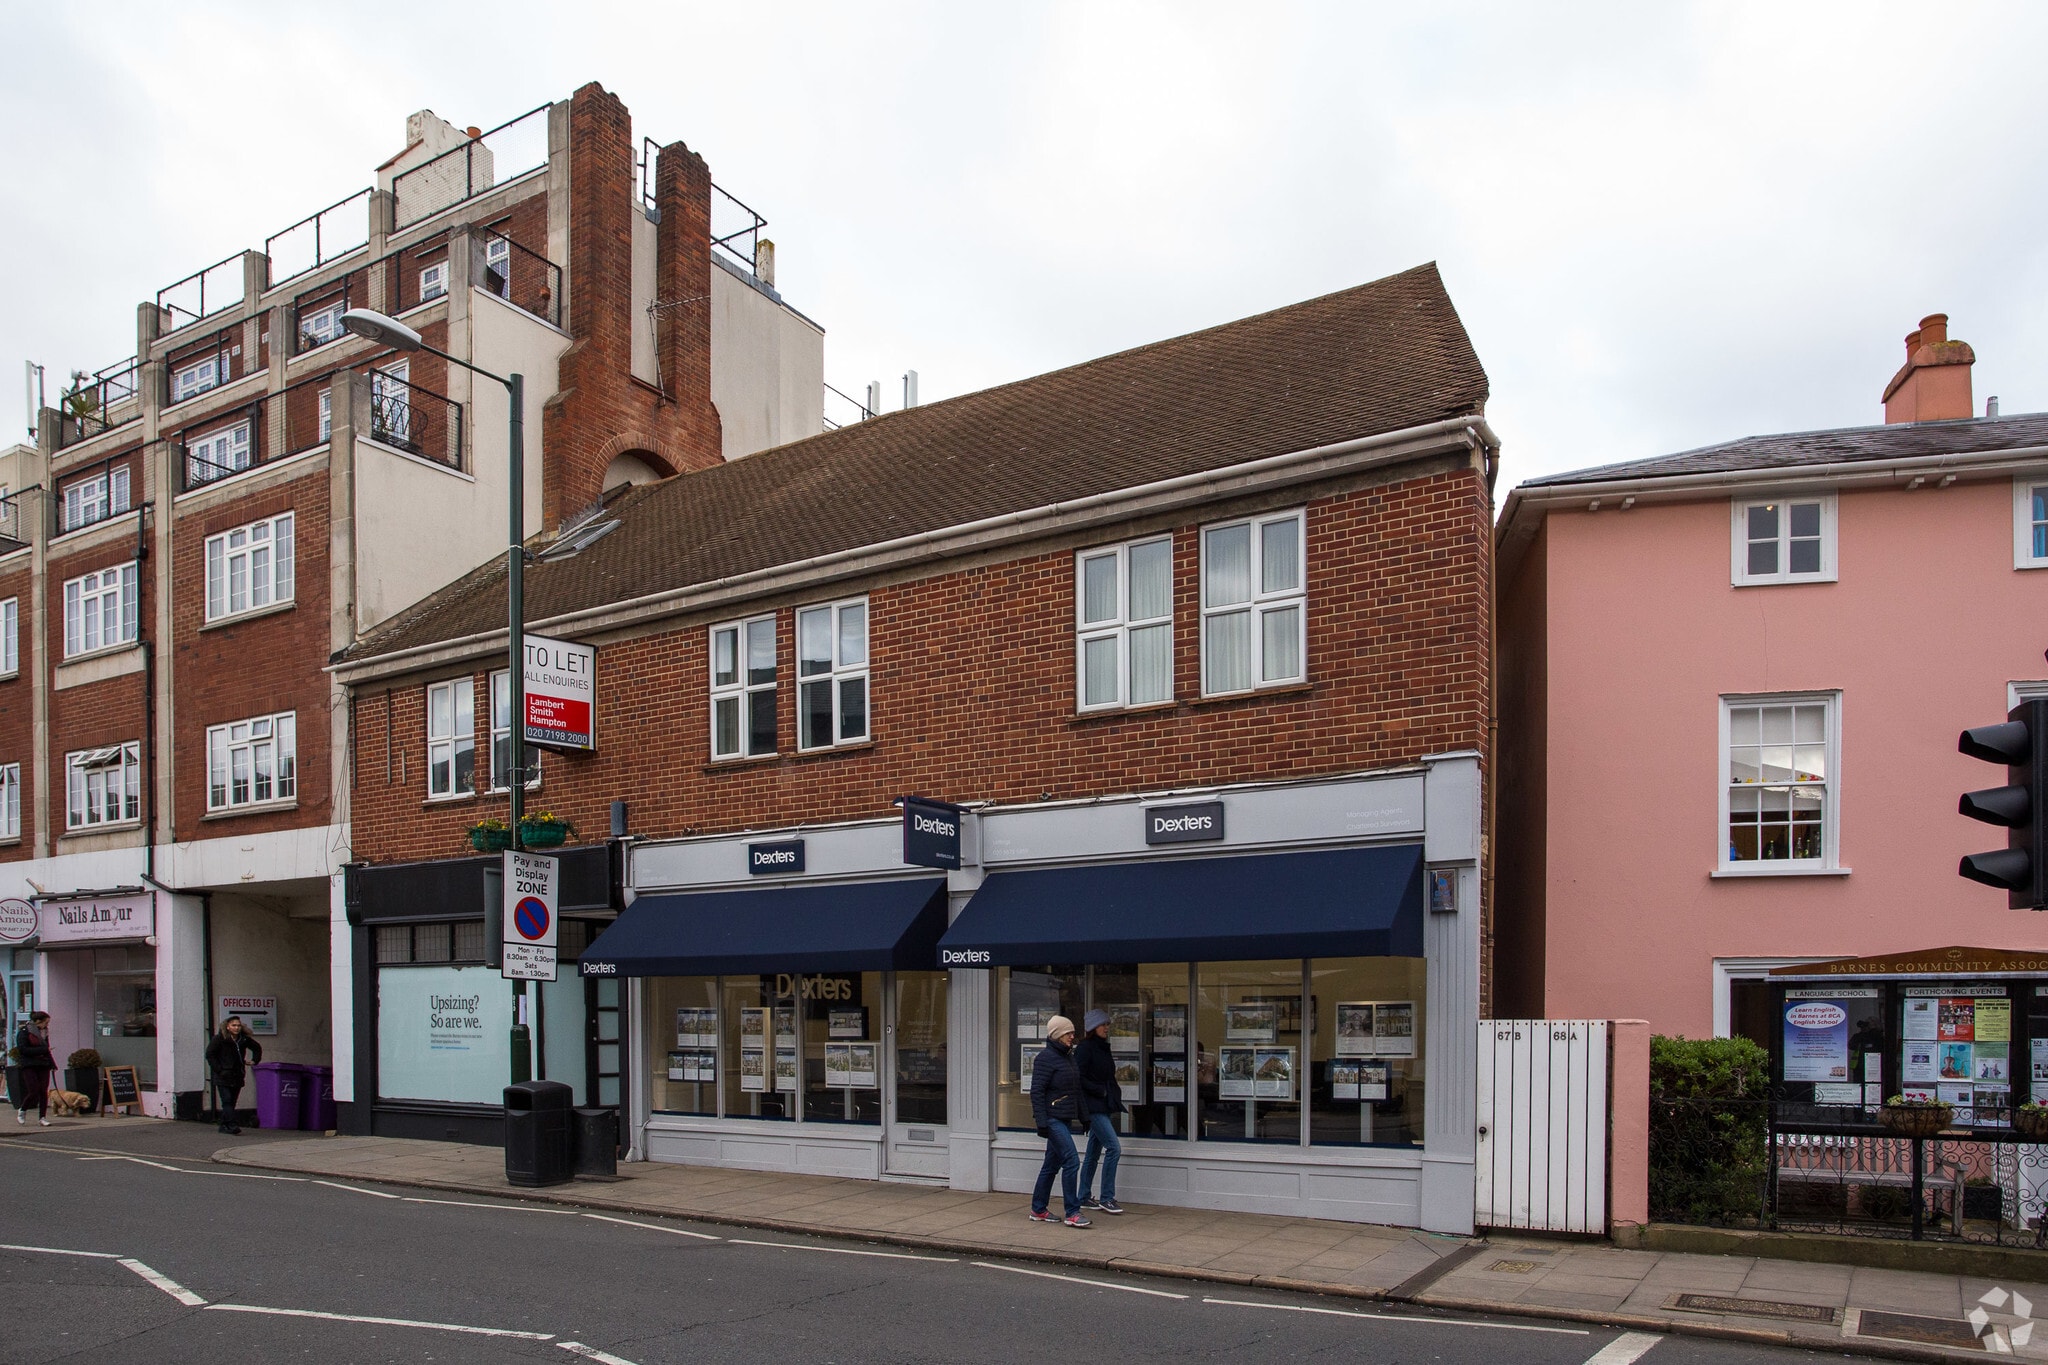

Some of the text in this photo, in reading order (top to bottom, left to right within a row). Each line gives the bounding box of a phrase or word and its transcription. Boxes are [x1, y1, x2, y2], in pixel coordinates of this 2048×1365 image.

[525, 644, 589, 674] TO LET
[524, 671, 589, 690] ALL ENQUIRIES
[530, 696, 565, 710] Lambert
[530, 706, 554, 717] Smith
[530, 715, 567, 728] Hampton
[527, 727, 588, 744] 020 7198 2000
[914, 814, 955, 837] Dexters
[1154, 815, 1212, 833] Dexters
[513, 855, 551, 869] Pay and
[754, 850, 795, 865] Dexters
[515, 868, 549, 882] Display
[516, 881, 548, 895] ZONE
[0, 906, 29, 915] Nails
[59, 906, 88, 925] Nails
[506, 953, 528, 961] 8.30am
[943, 949, 990, 963] Dexters
[511, 968, 524, 976] 8am
[524, 962, 538, 970] Sats
[583, 961, 616, 974] Dexters
[1830, 963, 1886, 973] BARNES
[1895, 961, 1992, 972] COMMUNITY
[223, 998, 274, 1008] OFFICES TO LET
[430, 994, 480, 1014] Upsizing?
[430, 1013, 482, 1029] So are we.
